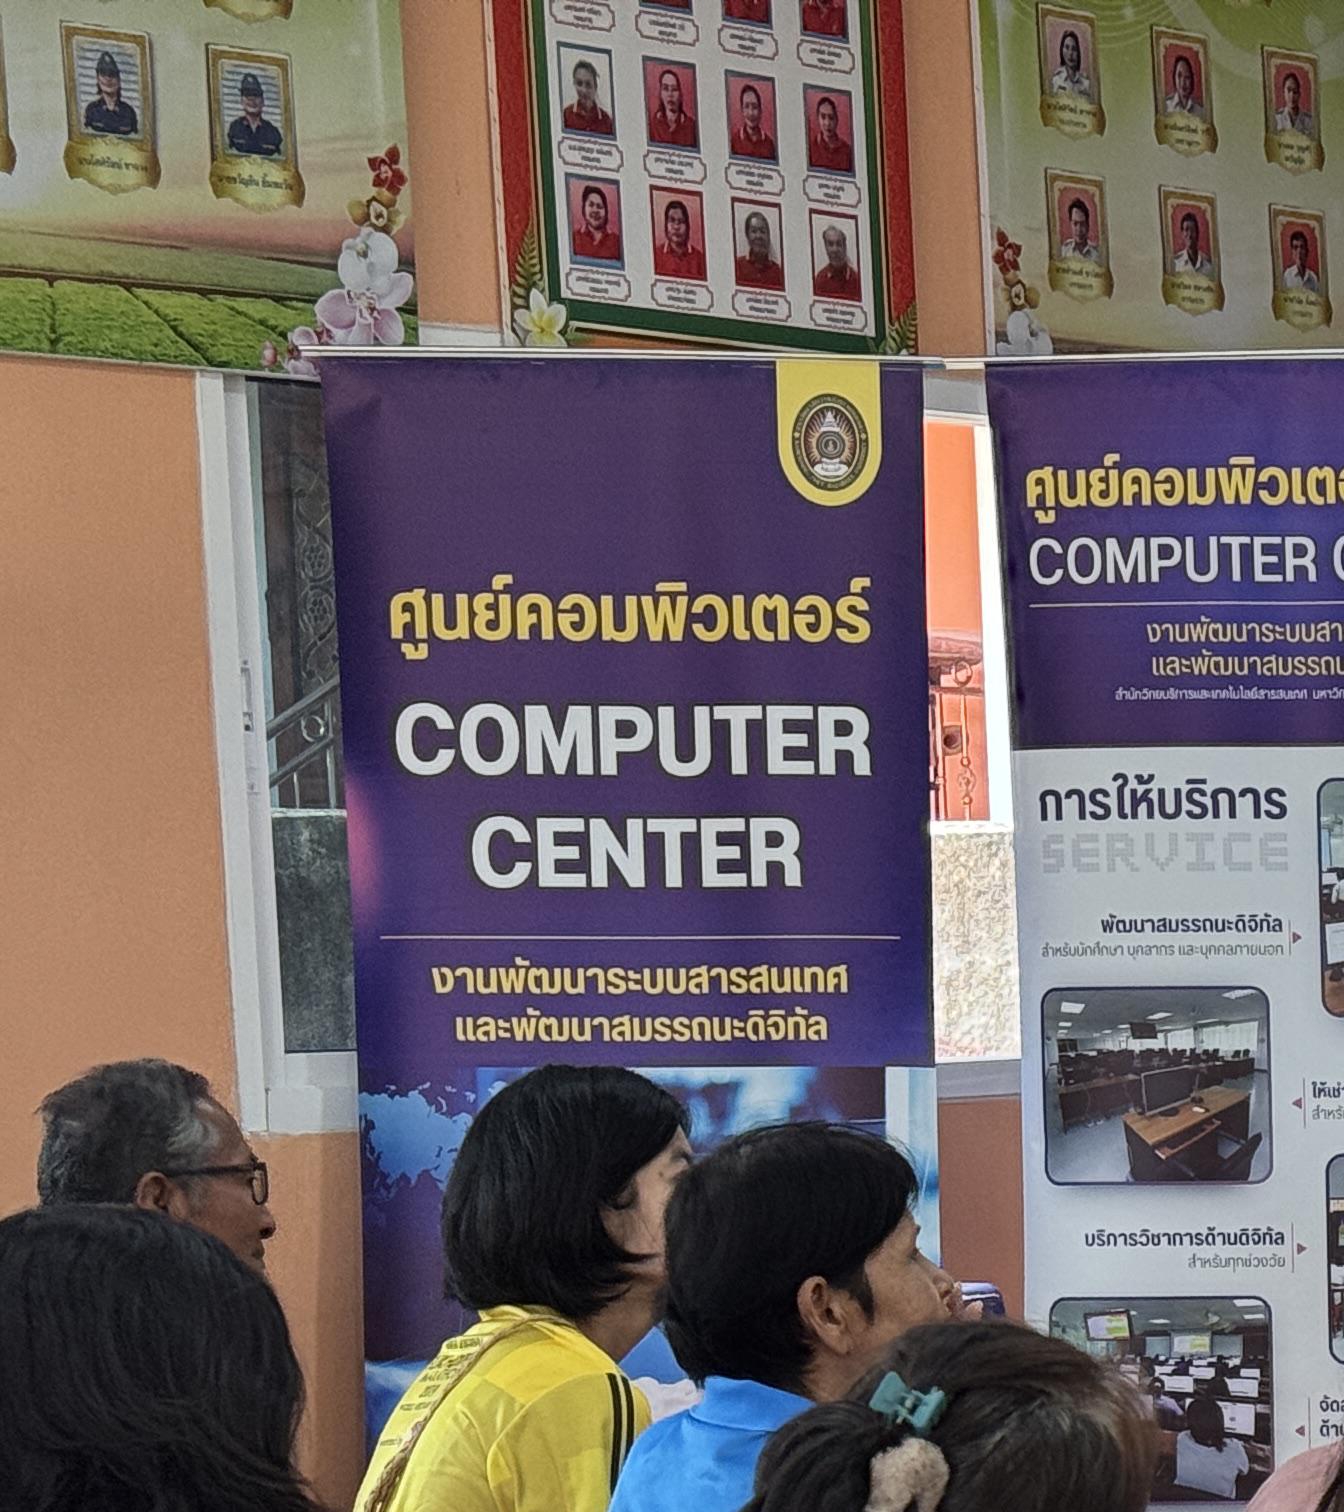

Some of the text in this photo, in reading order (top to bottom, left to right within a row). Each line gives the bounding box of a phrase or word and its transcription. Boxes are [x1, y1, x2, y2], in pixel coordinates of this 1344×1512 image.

[1028, 534, 1318, 586] COMPUTER
[389, 574, 871, 661] ศูนย์คอมพิวเตอร์
[395, 702, 872, 777] COMPUTER
[1038, 771, 1288, 823] การให้บริการ
[471, 815, 802, 889] CENTER
[1041, 832, 1289, 874] SERVICE
[1100, 913, 1284, 935] พัฒนาสมรรถนะดิจิทัล
[431, 957, 849, 995] งานพัฒนาระบบสารสนเทศ
[455, 1007, 829, 1042] และพัฒนาสมรรถนะดิจิทัล
[1084, 1226, 1286, 1248] บริการวิชาการด้านดิจิทัล
